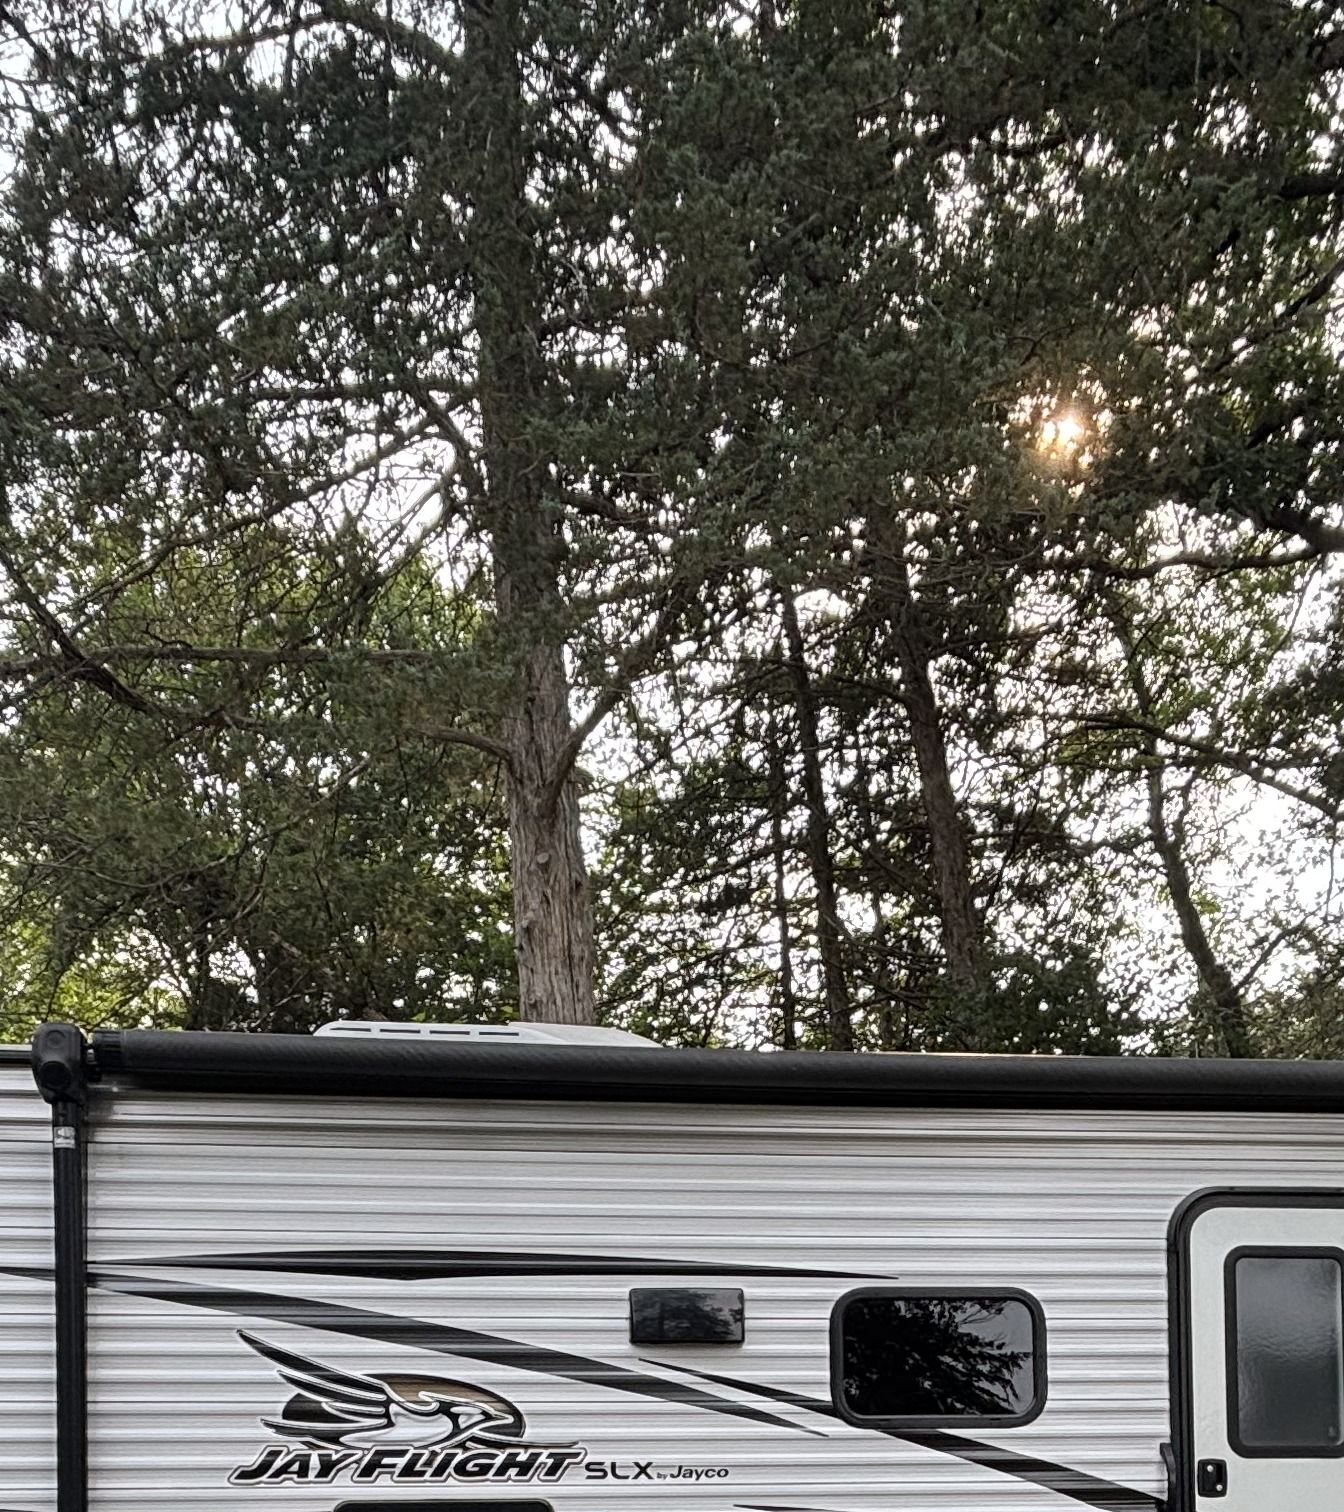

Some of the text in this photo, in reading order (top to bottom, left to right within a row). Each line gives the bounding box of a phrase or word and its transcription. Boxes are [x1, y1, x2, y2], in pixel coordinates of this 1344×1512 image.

[230, 1445, 729, 1484] JAY FLIGHT SLX by Jayco
